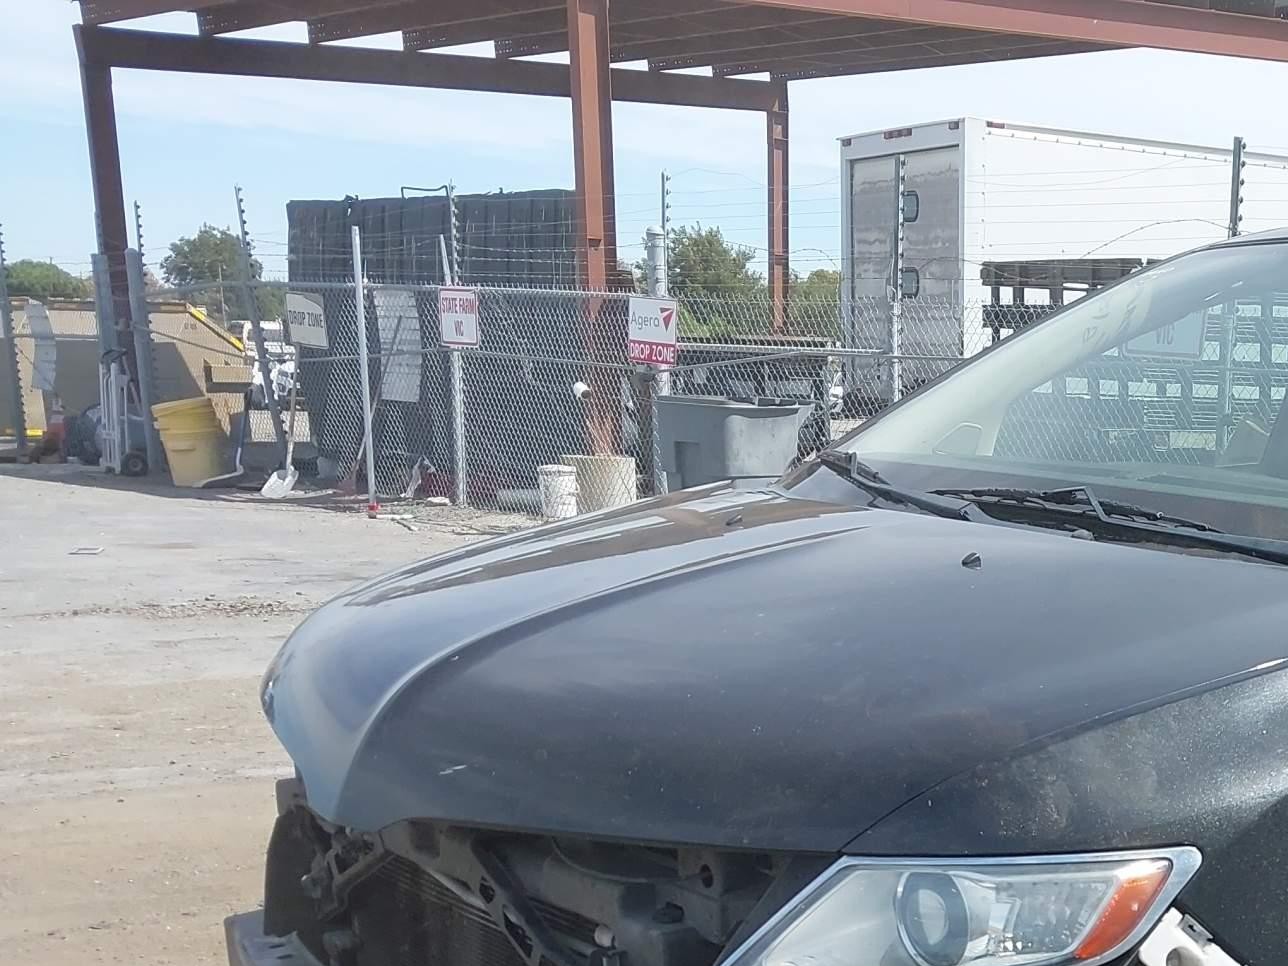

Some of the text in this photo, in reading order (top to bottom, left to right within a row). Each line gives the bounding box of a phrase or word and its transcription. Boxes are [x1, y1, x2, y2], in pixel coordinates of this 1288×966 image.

[442, 297, 458, 313] STATE
[288, 310, 323, 329] DROP ZONE
[630, 342, 675, 362] DROP ZONE
